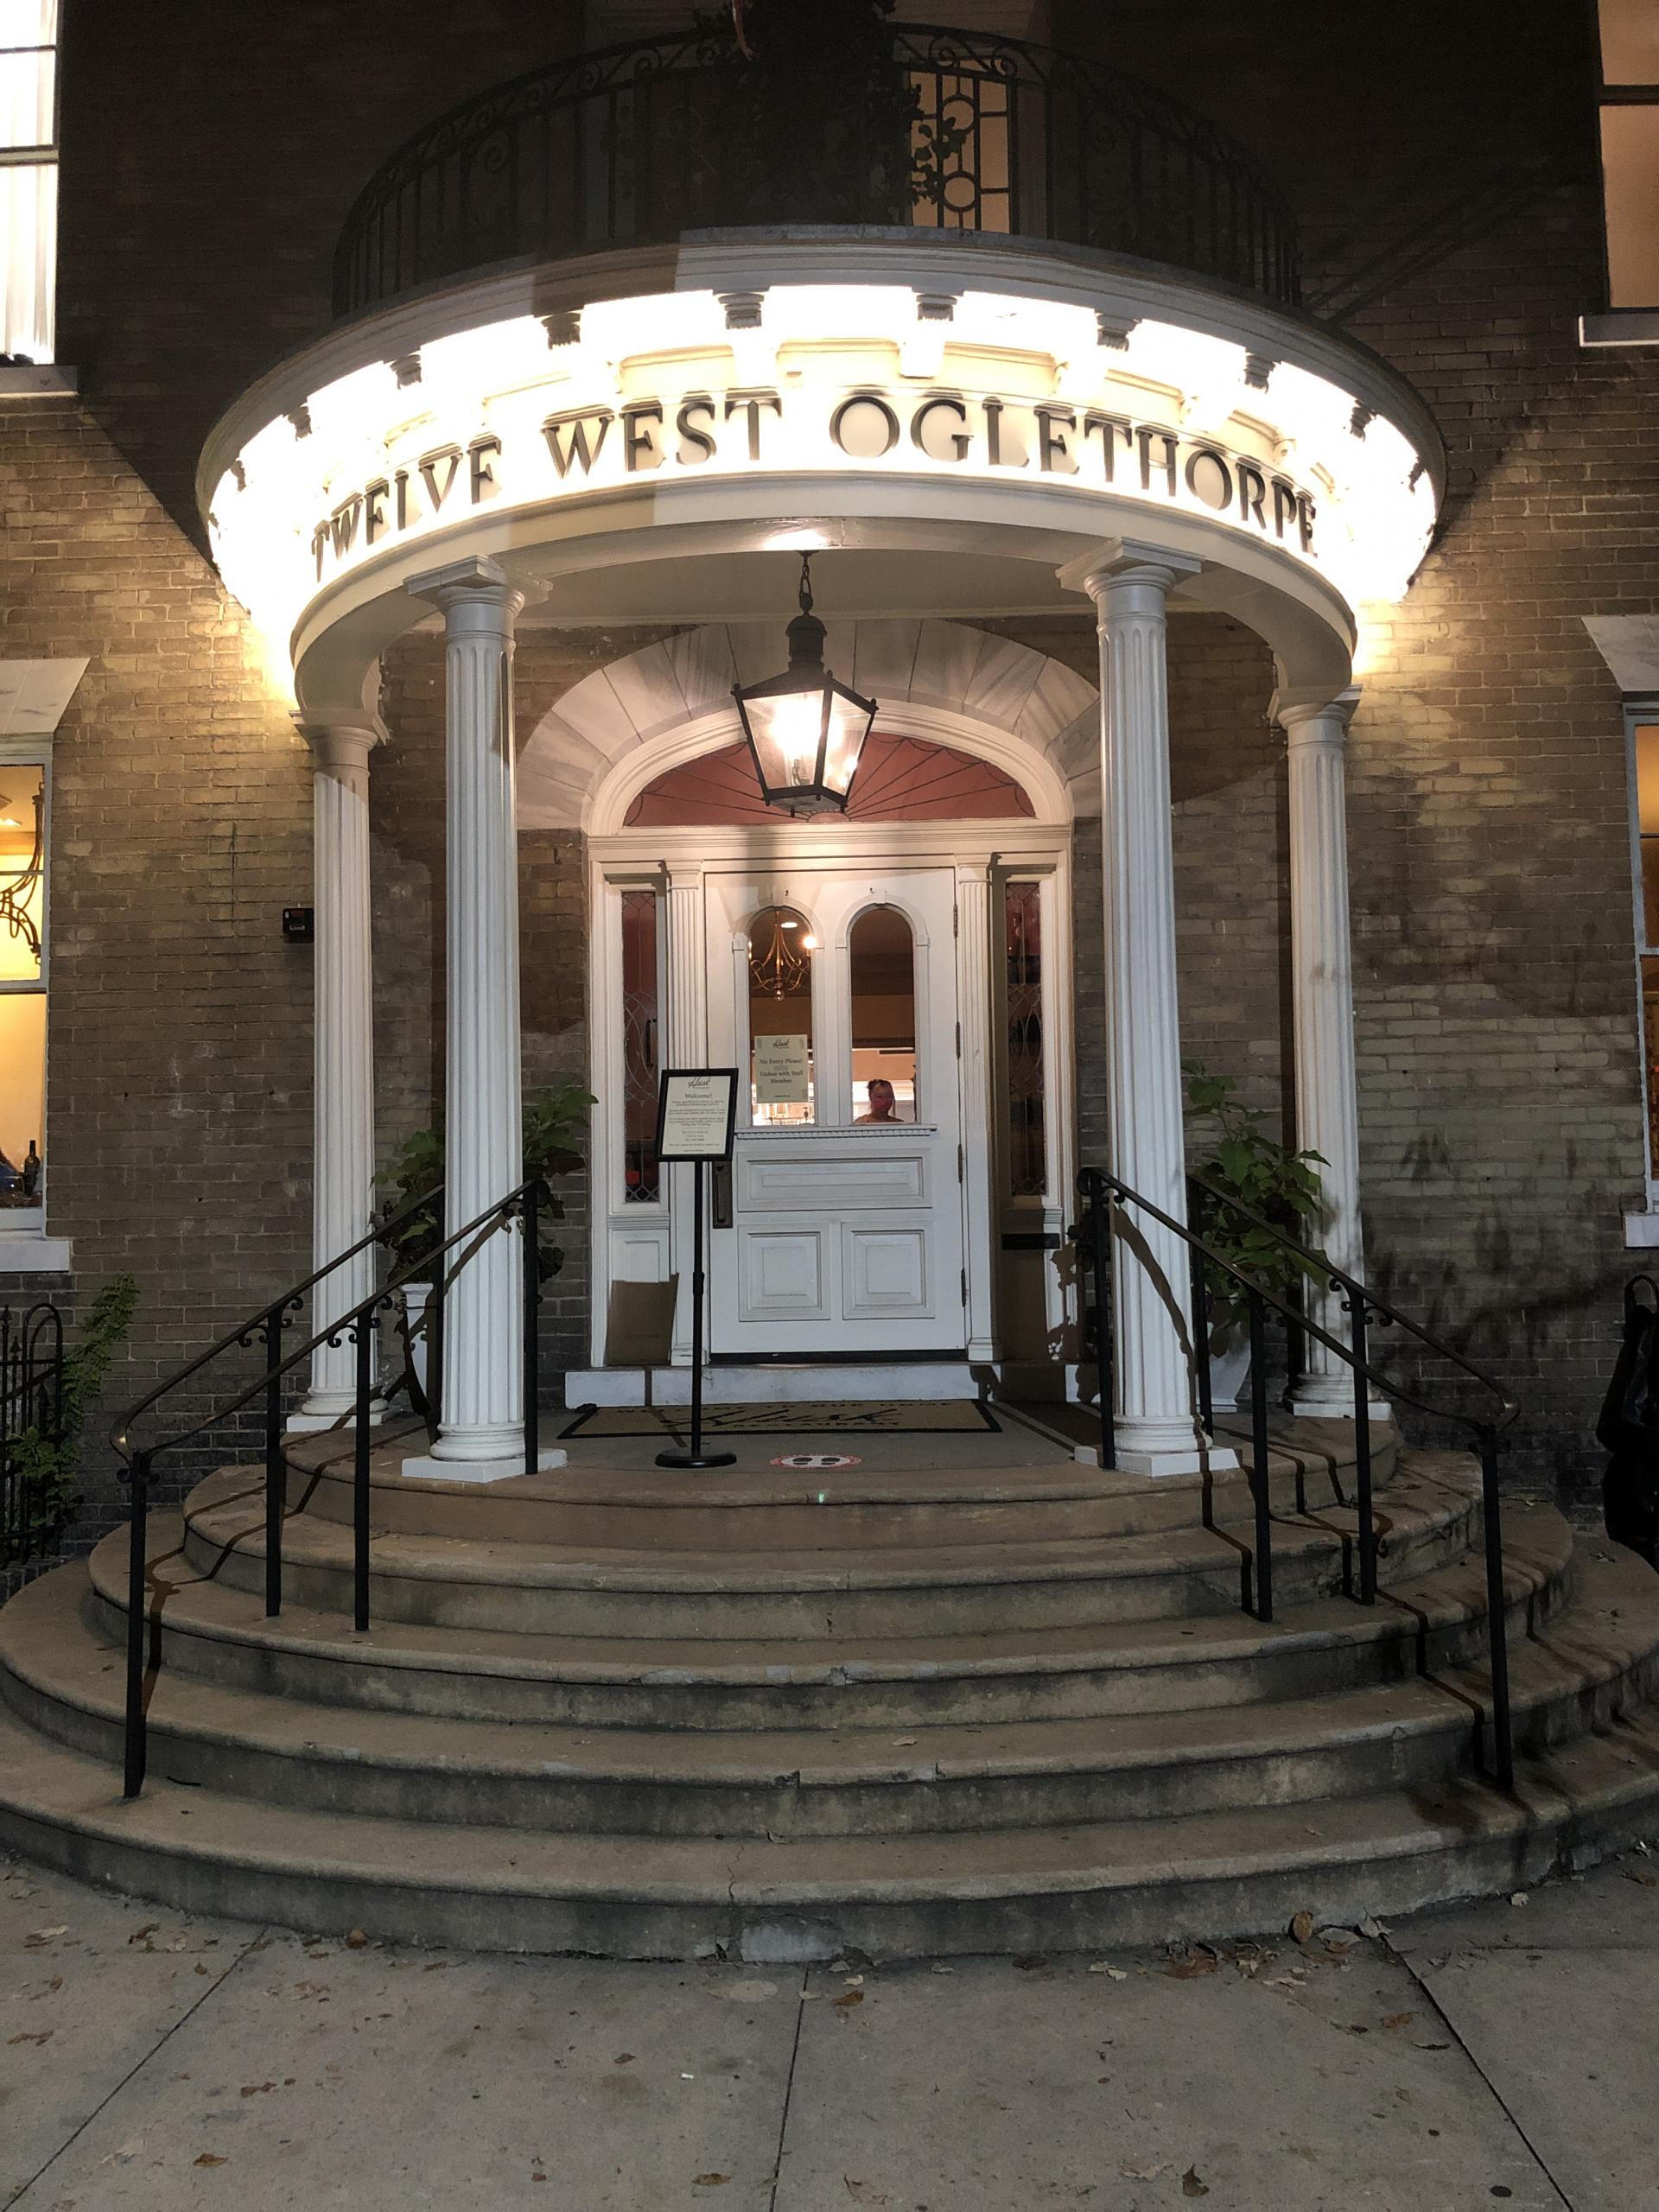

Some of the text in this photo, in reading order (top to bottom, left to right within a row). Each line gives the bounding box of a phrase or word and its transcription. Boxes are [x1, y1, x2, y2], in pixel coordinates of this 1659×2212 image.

[311, 396, 1319, 582] TWELVE WEST OGLETHORPE
[688, 1077, 711, 1088] Husk
